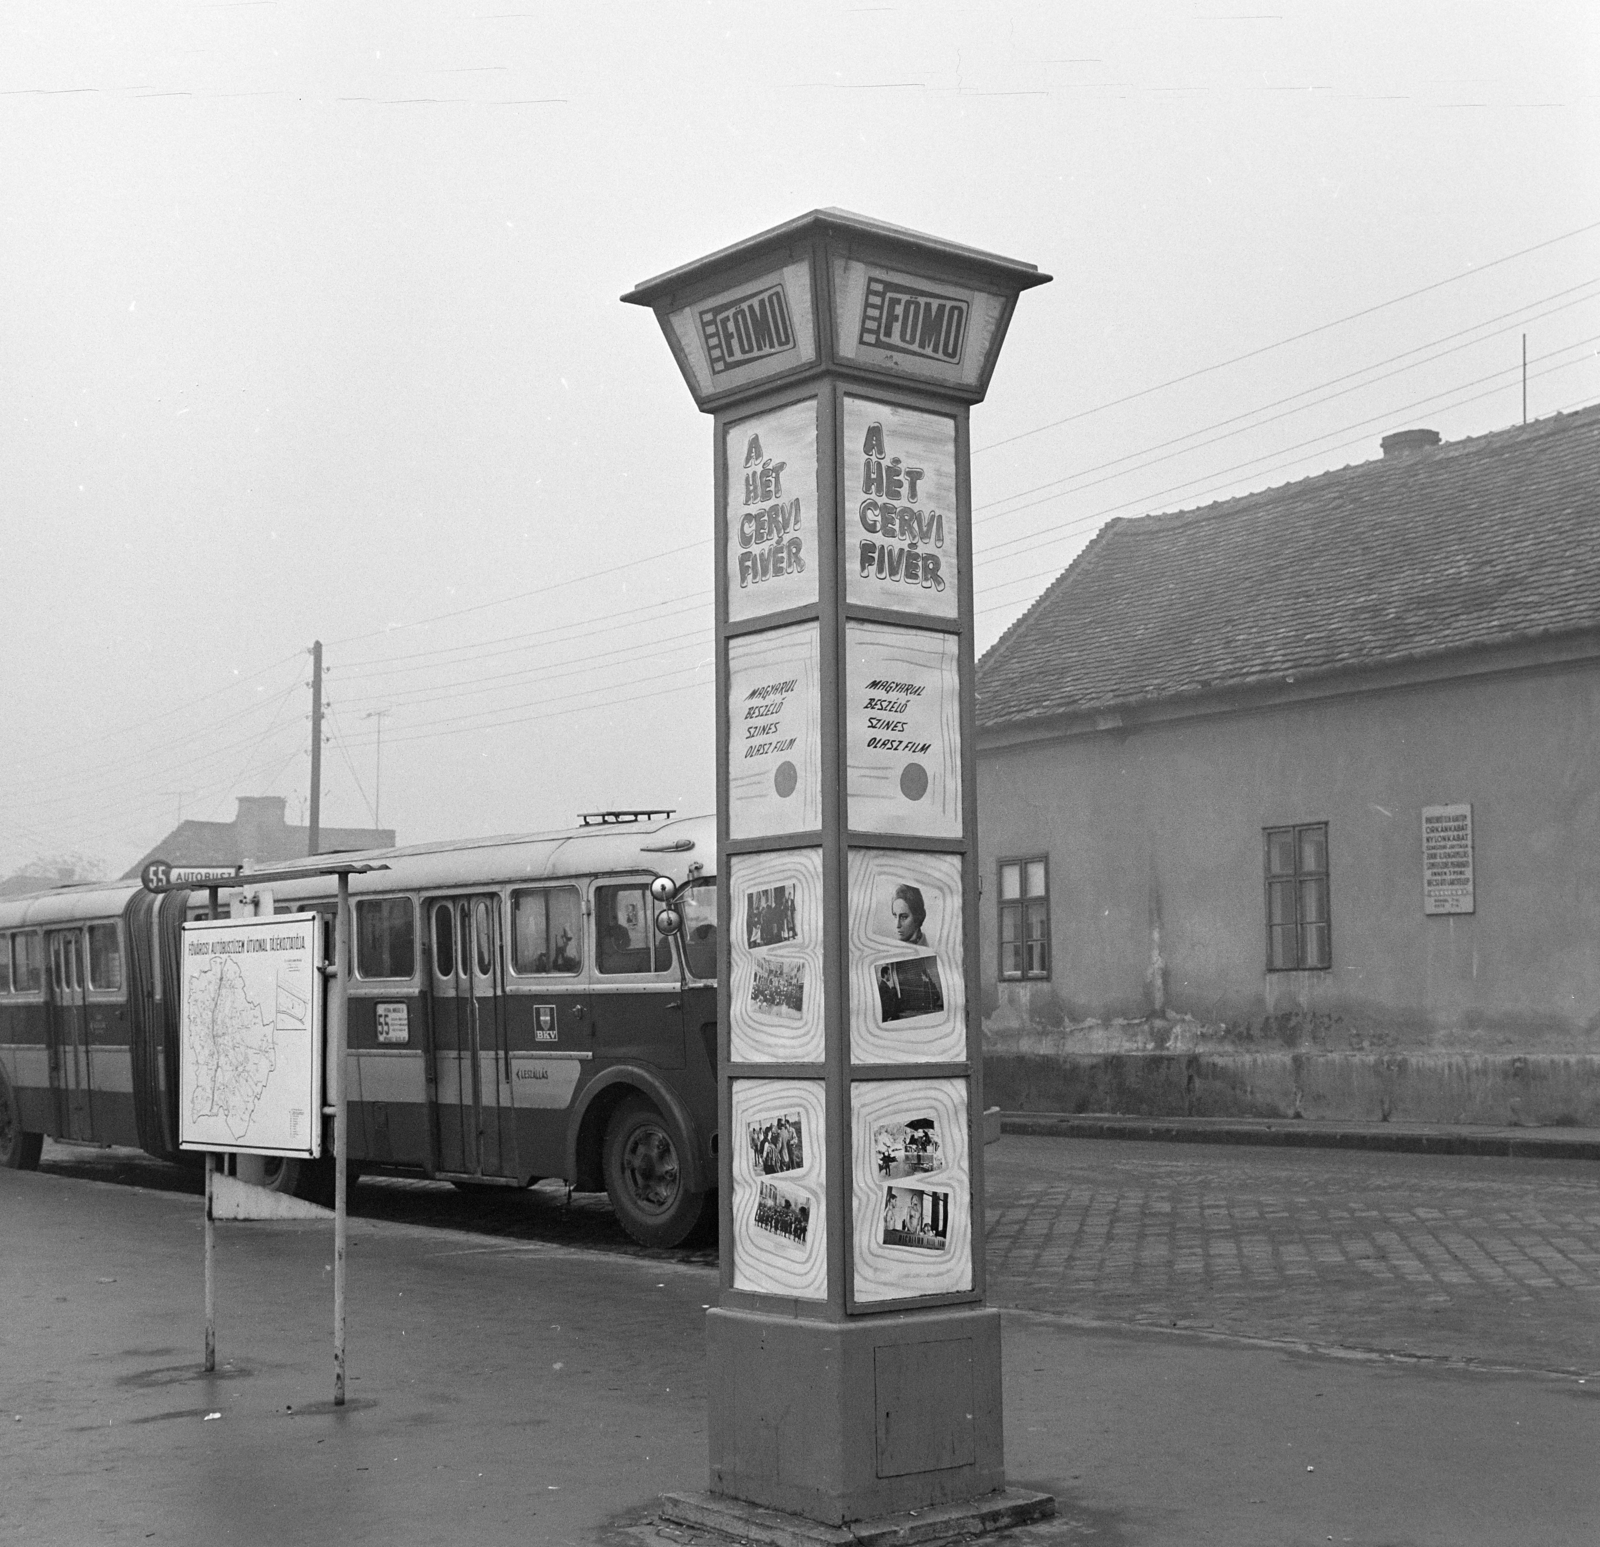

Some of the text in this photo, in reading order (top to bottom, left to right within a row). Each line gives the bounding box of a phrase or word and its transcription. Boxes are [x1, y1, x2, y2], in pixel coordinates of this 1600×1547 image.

[744, 433, 763, 468] A
[863, 422, 886, 460] A
[743, 458, 787, 505] HÉT
[862, 457, 925, 503] HÉT
[738, 498, 801, 549] CERVI
[859, 498, 944, 548] CERVI
[738, 536, 806, 588] FIVÉR
[859, 539, 945, 592] FIVÉR
[744, 679, 798, 702] MAGYARUL
[865, 679, 926, 696] MAGYARUL
[745, 721, 780, 740] SZINES
[867, 717, 908, 732] SZINES
[744, 736, 798, 759] OLASZ FILM
[867, 737, 932, 755] OLASZ FILM
[149, 866, 167, 889] 55
[377, 1013, 390, 1036] 55
[536, 1030, 556, 1039] BKV
